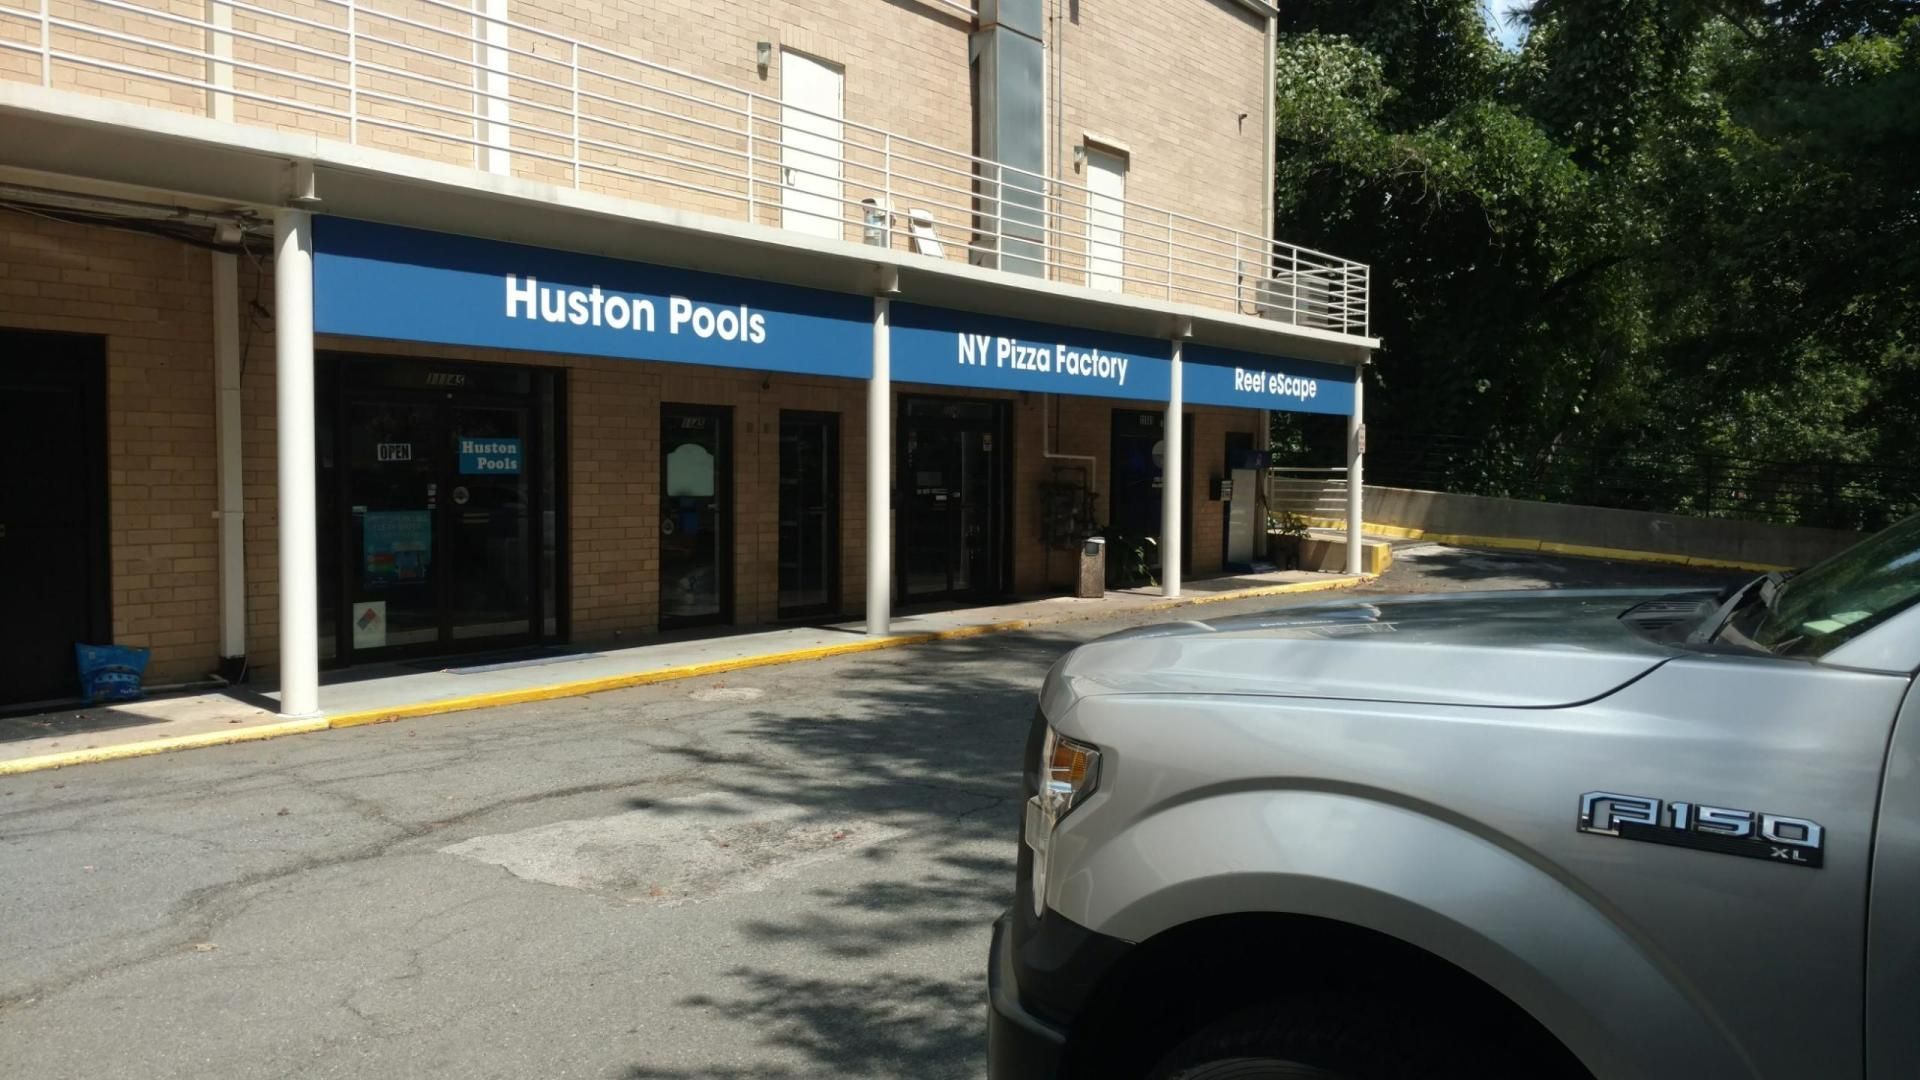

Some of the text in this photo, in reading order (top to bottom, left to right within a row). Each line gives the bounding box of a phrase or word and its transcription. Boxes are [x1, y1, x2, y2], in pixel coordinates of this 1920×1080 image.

[506, 273, 766, 344] Huston Pools
[957, 332, 1129, 386] NY Pizza Factory
[1234, 366, 1318, 403] Reef eScape
[379, 444, 410, 460] OPEN
[462, 440, 517, 454] Huston
[478, 457, 518, 470] Pools
[1771, 846, 1808, 862] XL
